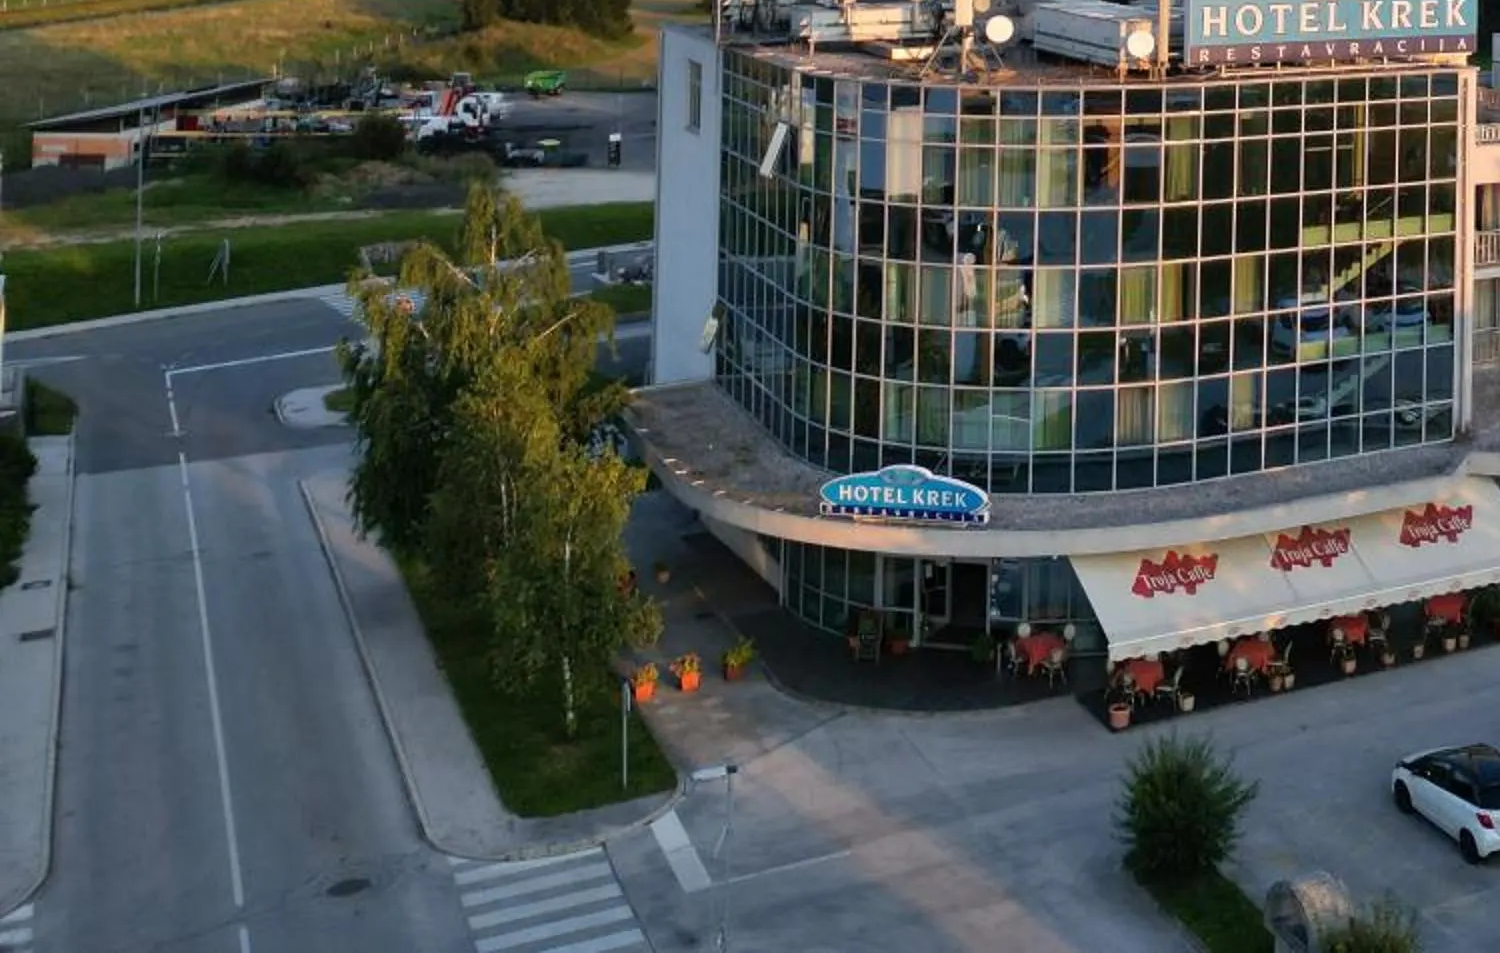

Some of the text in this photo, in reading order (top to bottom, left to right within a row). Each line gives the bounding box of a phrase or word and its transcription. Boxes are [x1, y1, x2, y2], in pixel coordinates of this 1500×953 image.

[1203, 1, 1346, 37] HOTEL
[1199, 38, 1467, 62] RESTAVRACIJA
[839, 484, 967, 508] HOTEL KREK
[1406, 523, 1440, 540] Troja
[1279, 547, 1315, 566] Troja
[1140, 569, 1178, 590] Troja
